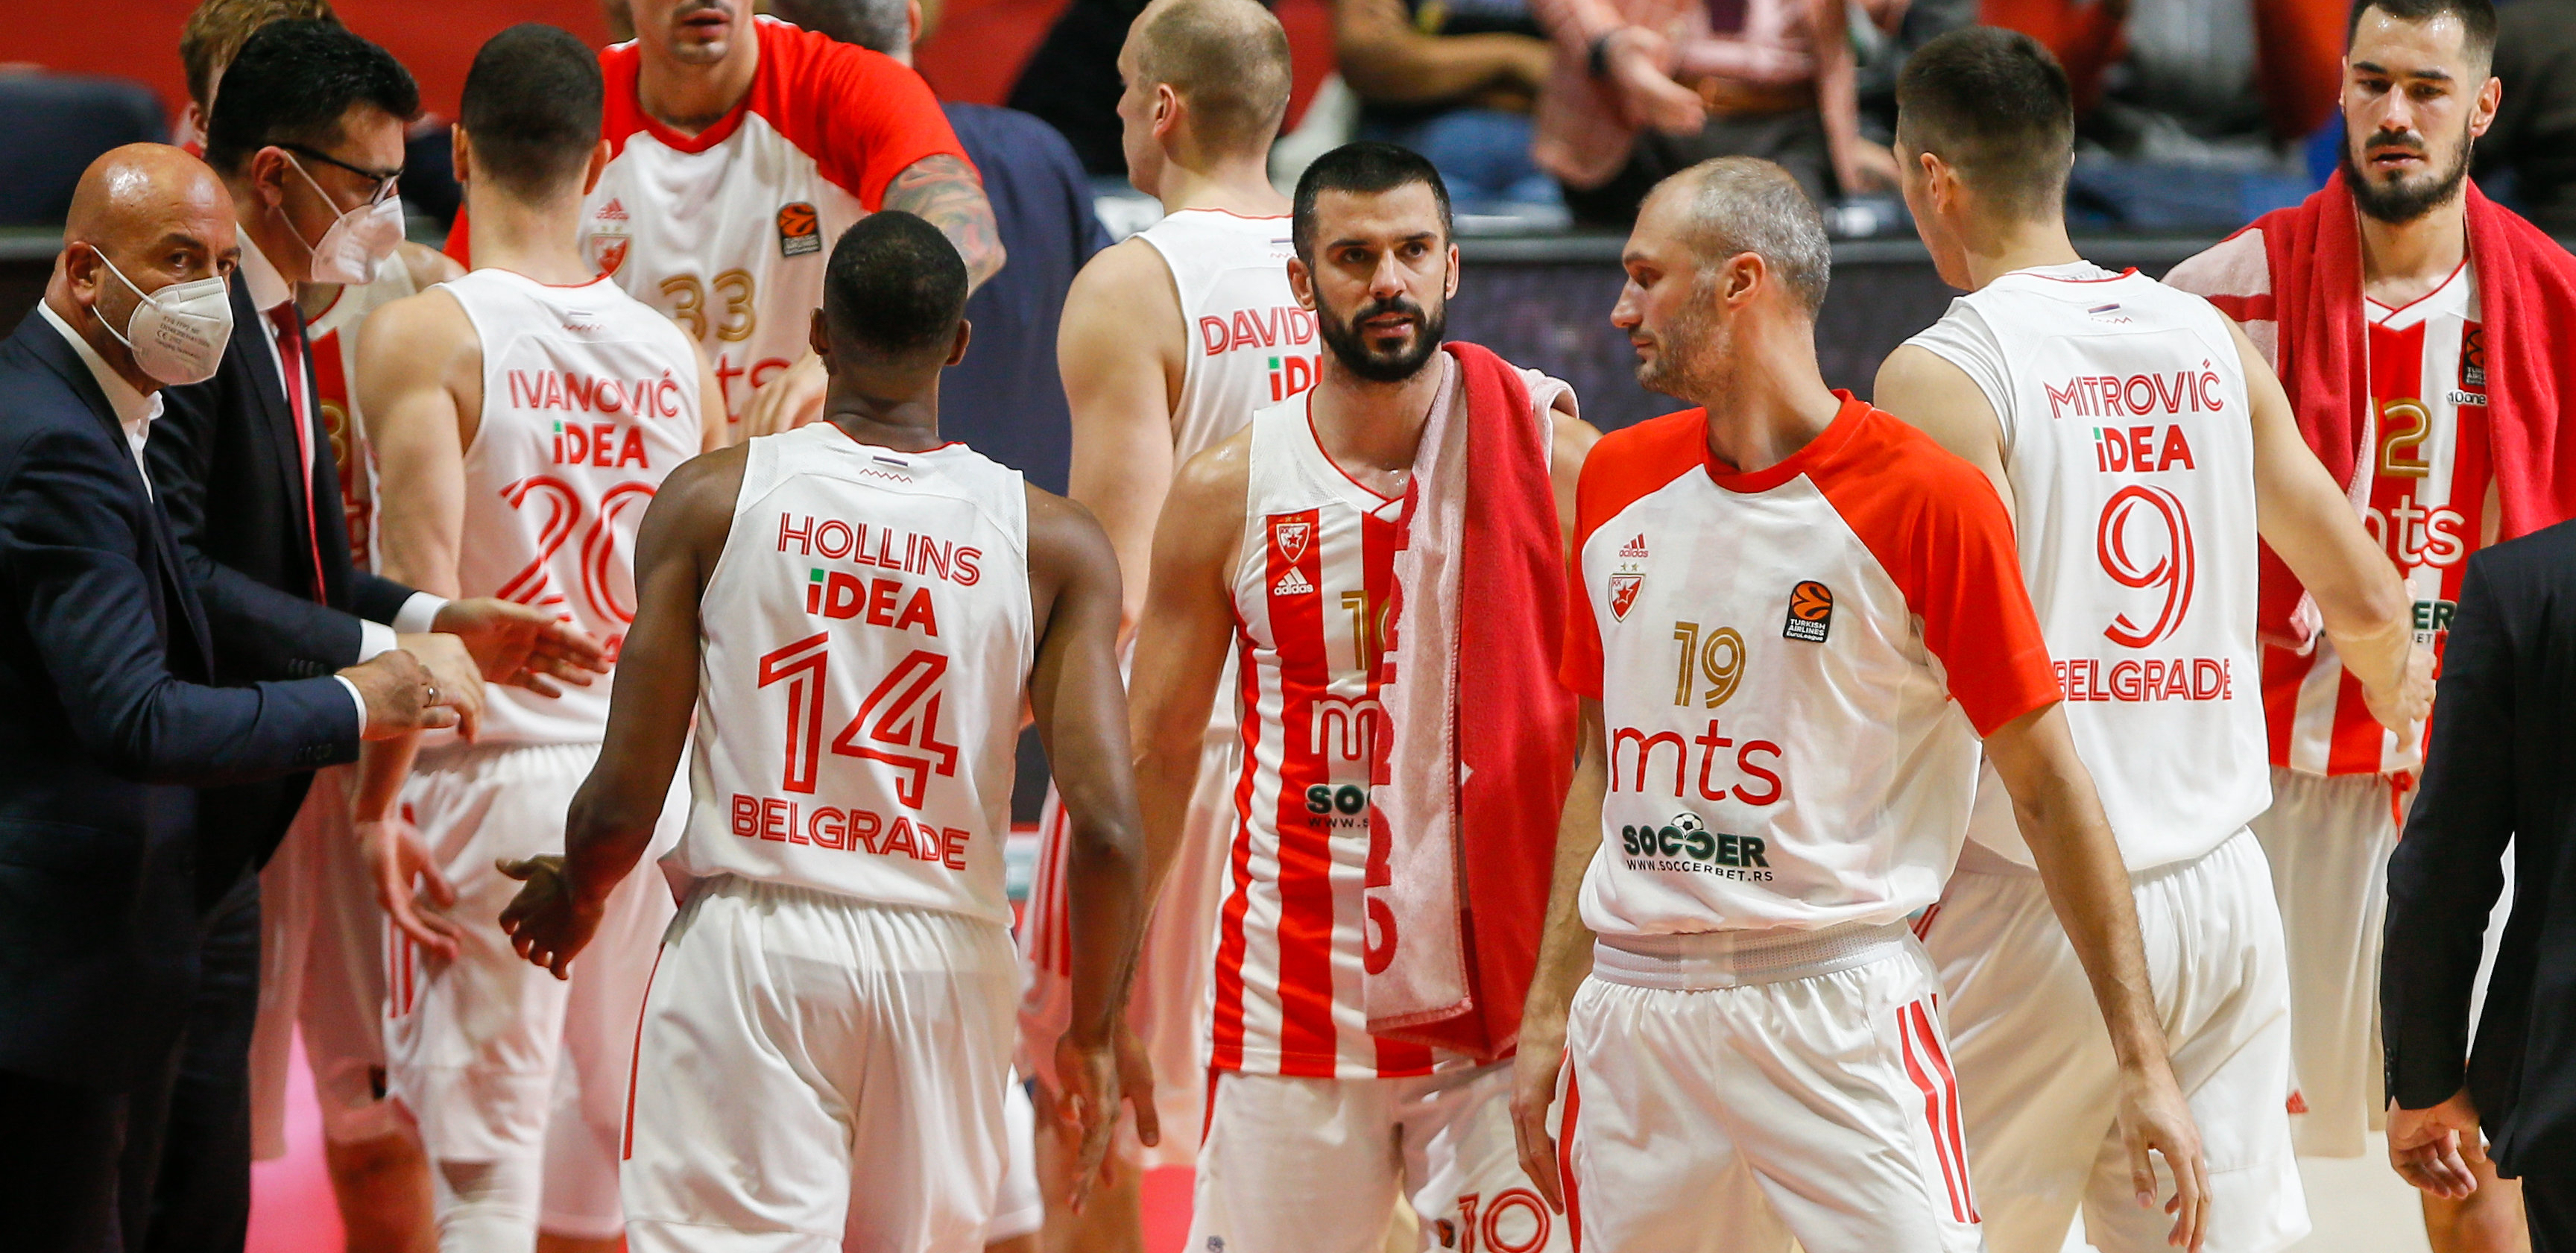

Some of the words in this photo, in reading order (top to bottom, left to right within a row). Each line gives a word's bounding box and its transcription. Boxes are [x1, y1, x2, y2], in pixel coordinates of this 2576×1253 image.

[659, 268, 756, 342] 33
[1199, 306, 1321, 356] DAVID
[508, 367, 678, 418] IVANOVIĆ
[1268, 356, 1322, 402] iD
[2042, 358, 2224, 419] MITROVIĆ
[553, 419, 648, 469] iDEA
[2094, 424, 2195, 472] iDEA
[2372, 397, 2431, 478] 2
[777, 511, 983, 587] HOLLINS
[1619, 548, 1649, 558] adidas
[2097, 484, 2194, 648] 9
[806, 568, 938, 637] iDEA
[1274, 584, 1314, 596] adidas
[1341, 590, 1393, 671] 1
[1788, 625, 1825, 636] AIRLINES
[1790, 618, 1826, 630] TURKISH
[2412, 600, 2457, 631] ER
[1673, 620, 1746, 709] 19
[2053, 657, 2233, 702] BELGRADE
[758, 631, 959, 811] 14
[1611, 719, 1782, 806] mts
[1306, 784, 1371, 815] SO
[732, 793, 970, 871] BELGRADE
[1622, 825, 1770, 868] SOCCER
[1626, 859, 1773, 882] WWW.SOCCERBET.RS
